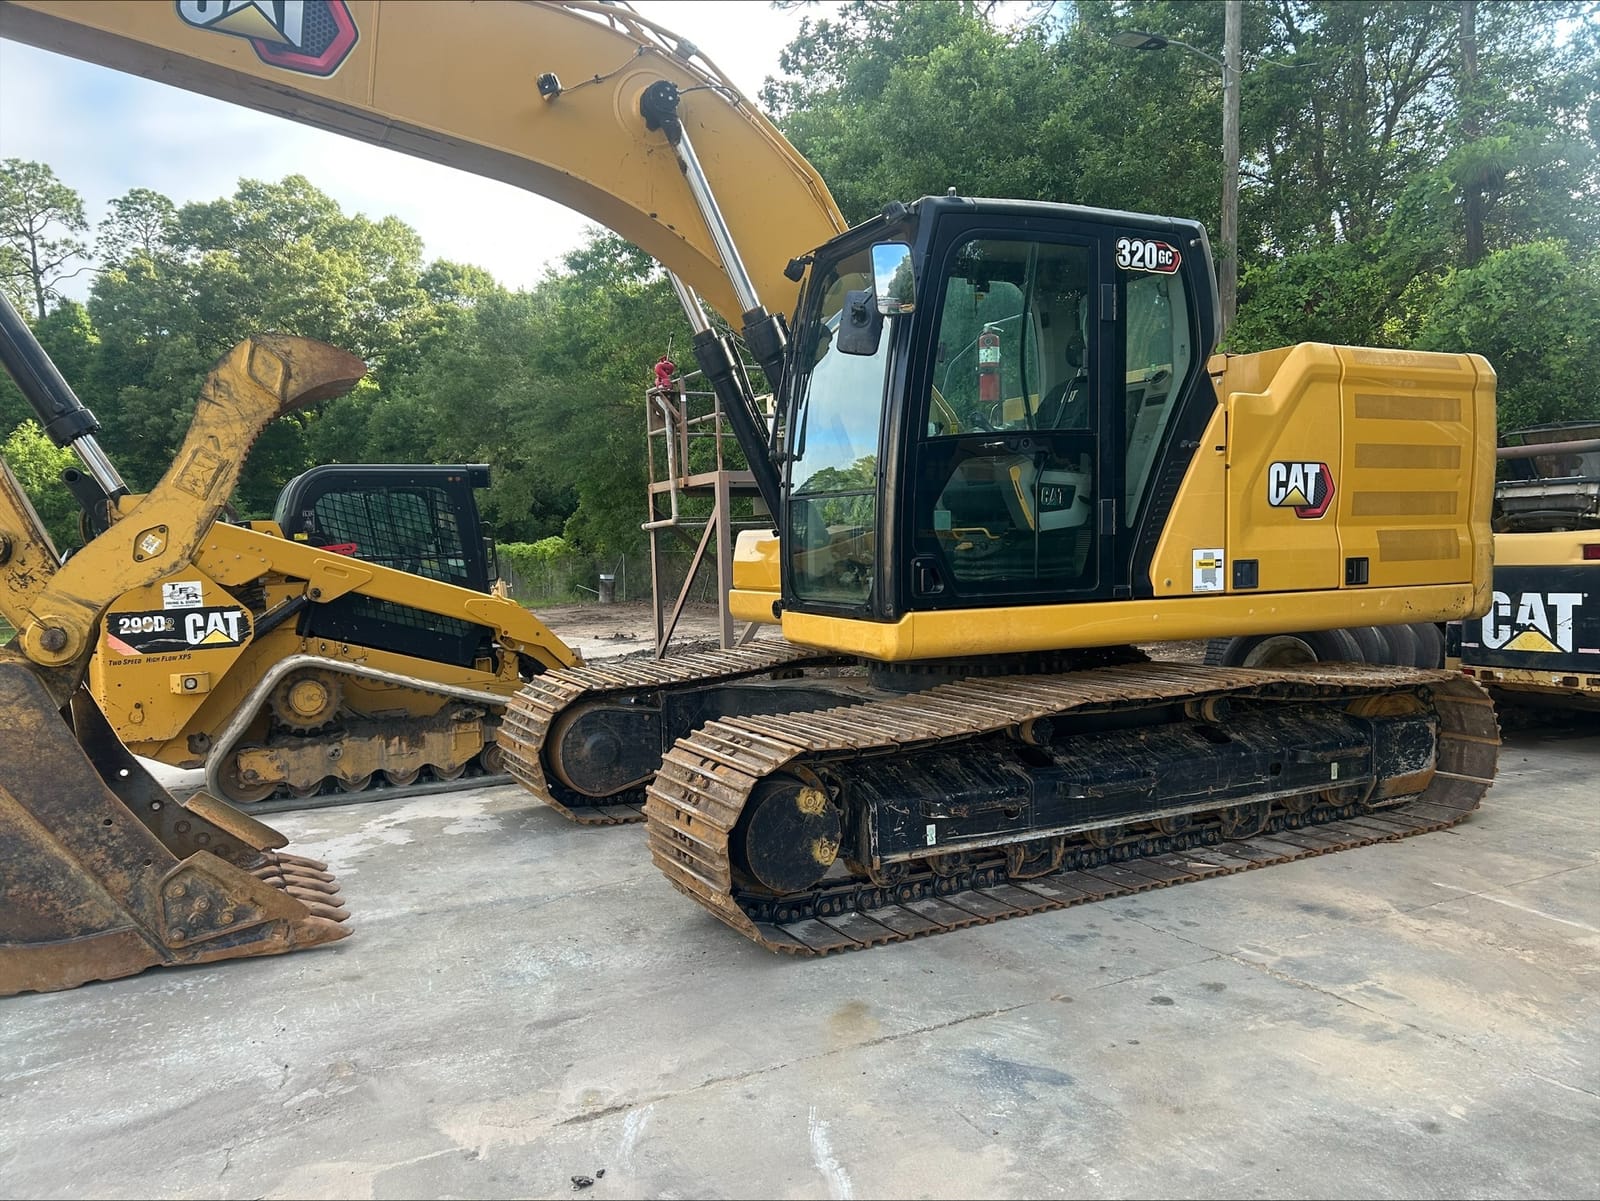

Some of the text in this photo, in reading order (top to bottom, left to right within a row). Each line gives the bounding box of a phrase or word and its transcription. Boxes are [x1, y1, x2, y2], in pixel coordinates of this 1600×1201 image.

[1117, 239, 1173, 269] 320 GC
[1269, 462, 1320, 506] CAT
[184, 611, 242, 645] CAT
[1482, 591, 1583, 654] CAT
